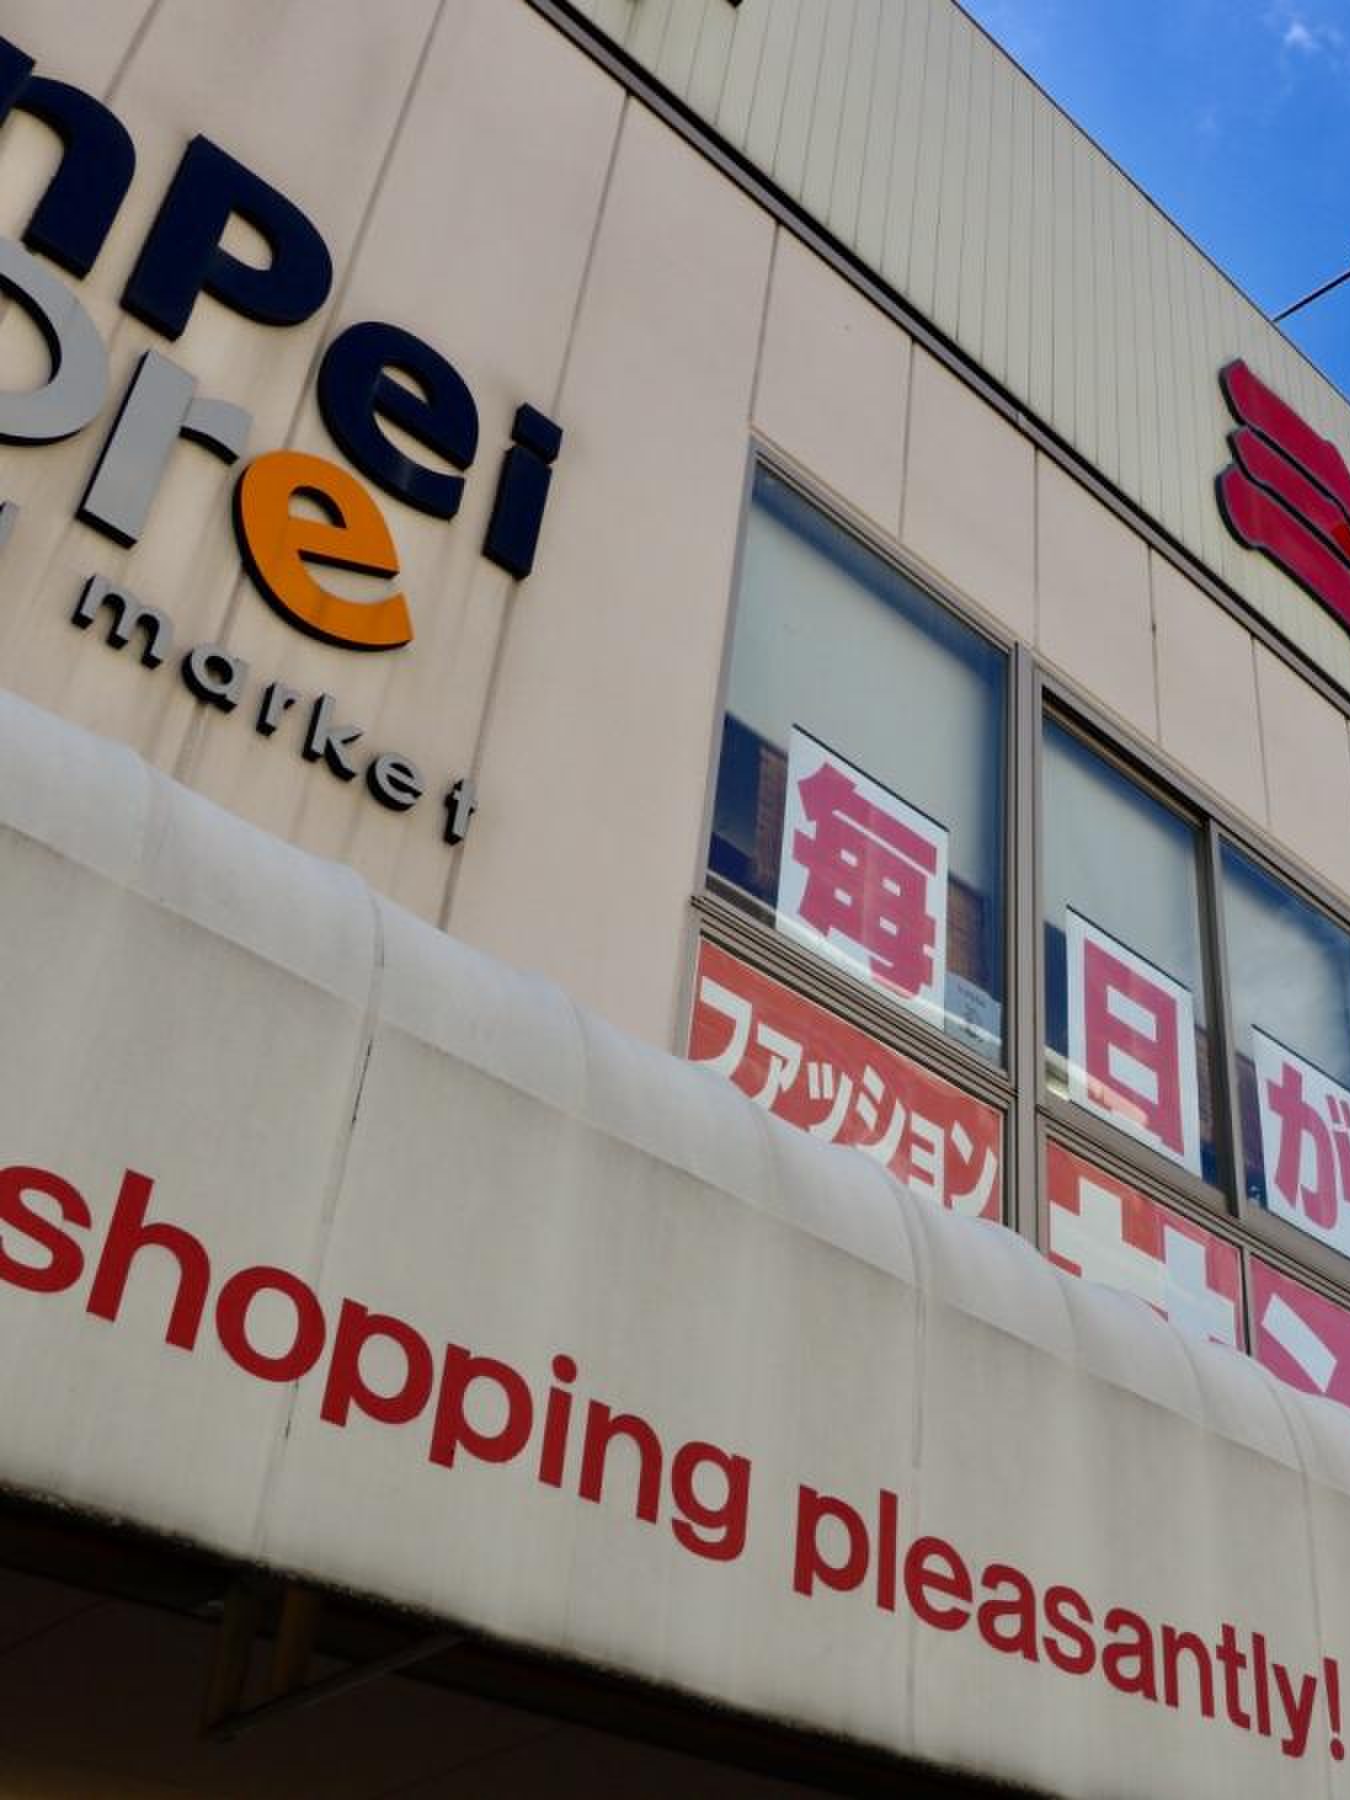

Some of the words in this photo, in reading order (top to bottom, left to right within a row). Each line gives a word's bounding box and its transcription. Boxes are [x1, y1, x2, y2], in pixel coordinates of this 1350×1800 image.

[71, 574, 478, 844] market
[0, 1166, 751, 1562] shopping
[793, 1484, 1344, 1760] pleasantly!
